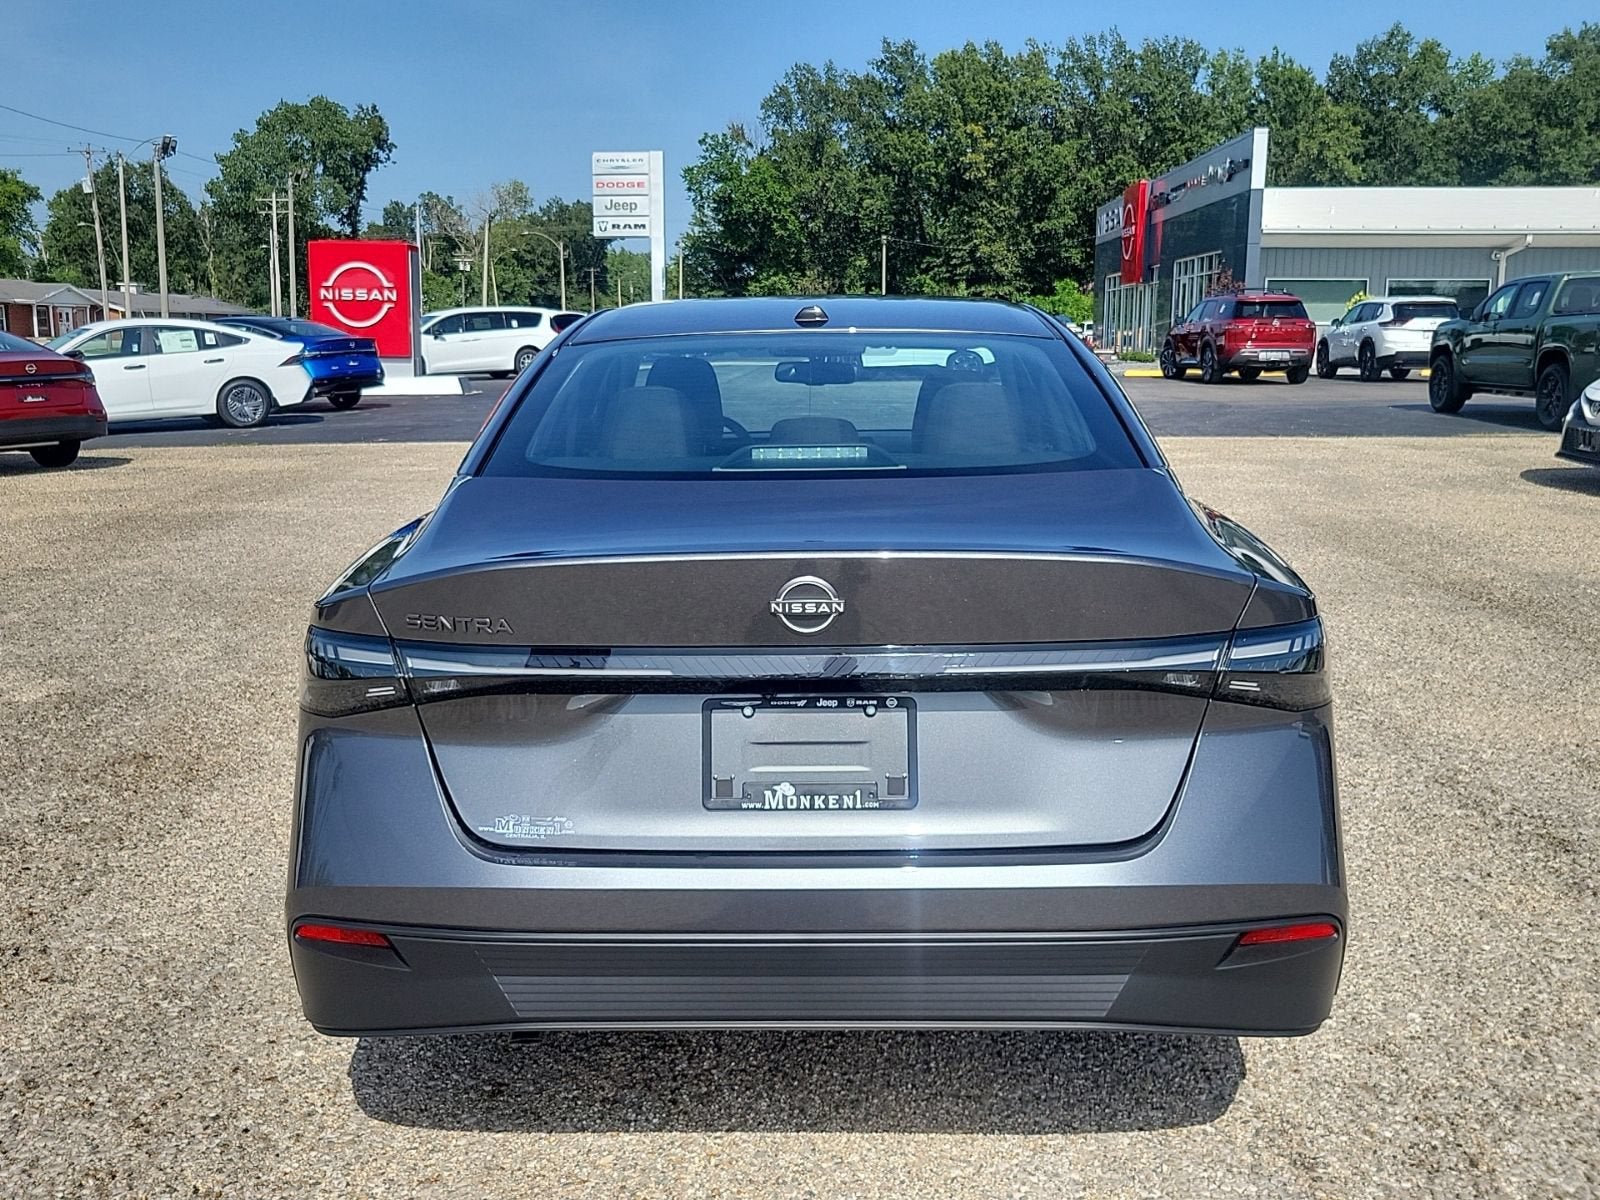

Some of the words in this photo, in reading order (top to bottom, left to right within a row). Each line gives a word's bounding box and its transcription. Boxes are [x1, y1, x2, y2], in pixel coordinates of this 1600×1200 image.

[596, 181, 645, 189] DODGE
[604, 199, 638, 213] Jeep
[320, 287, 397, 302] NISSAN
[771, 602, 844, 613] NISSAN
[406, 613, 515, 634] SENTRA
[816, 698, 838, 708] Jeep
